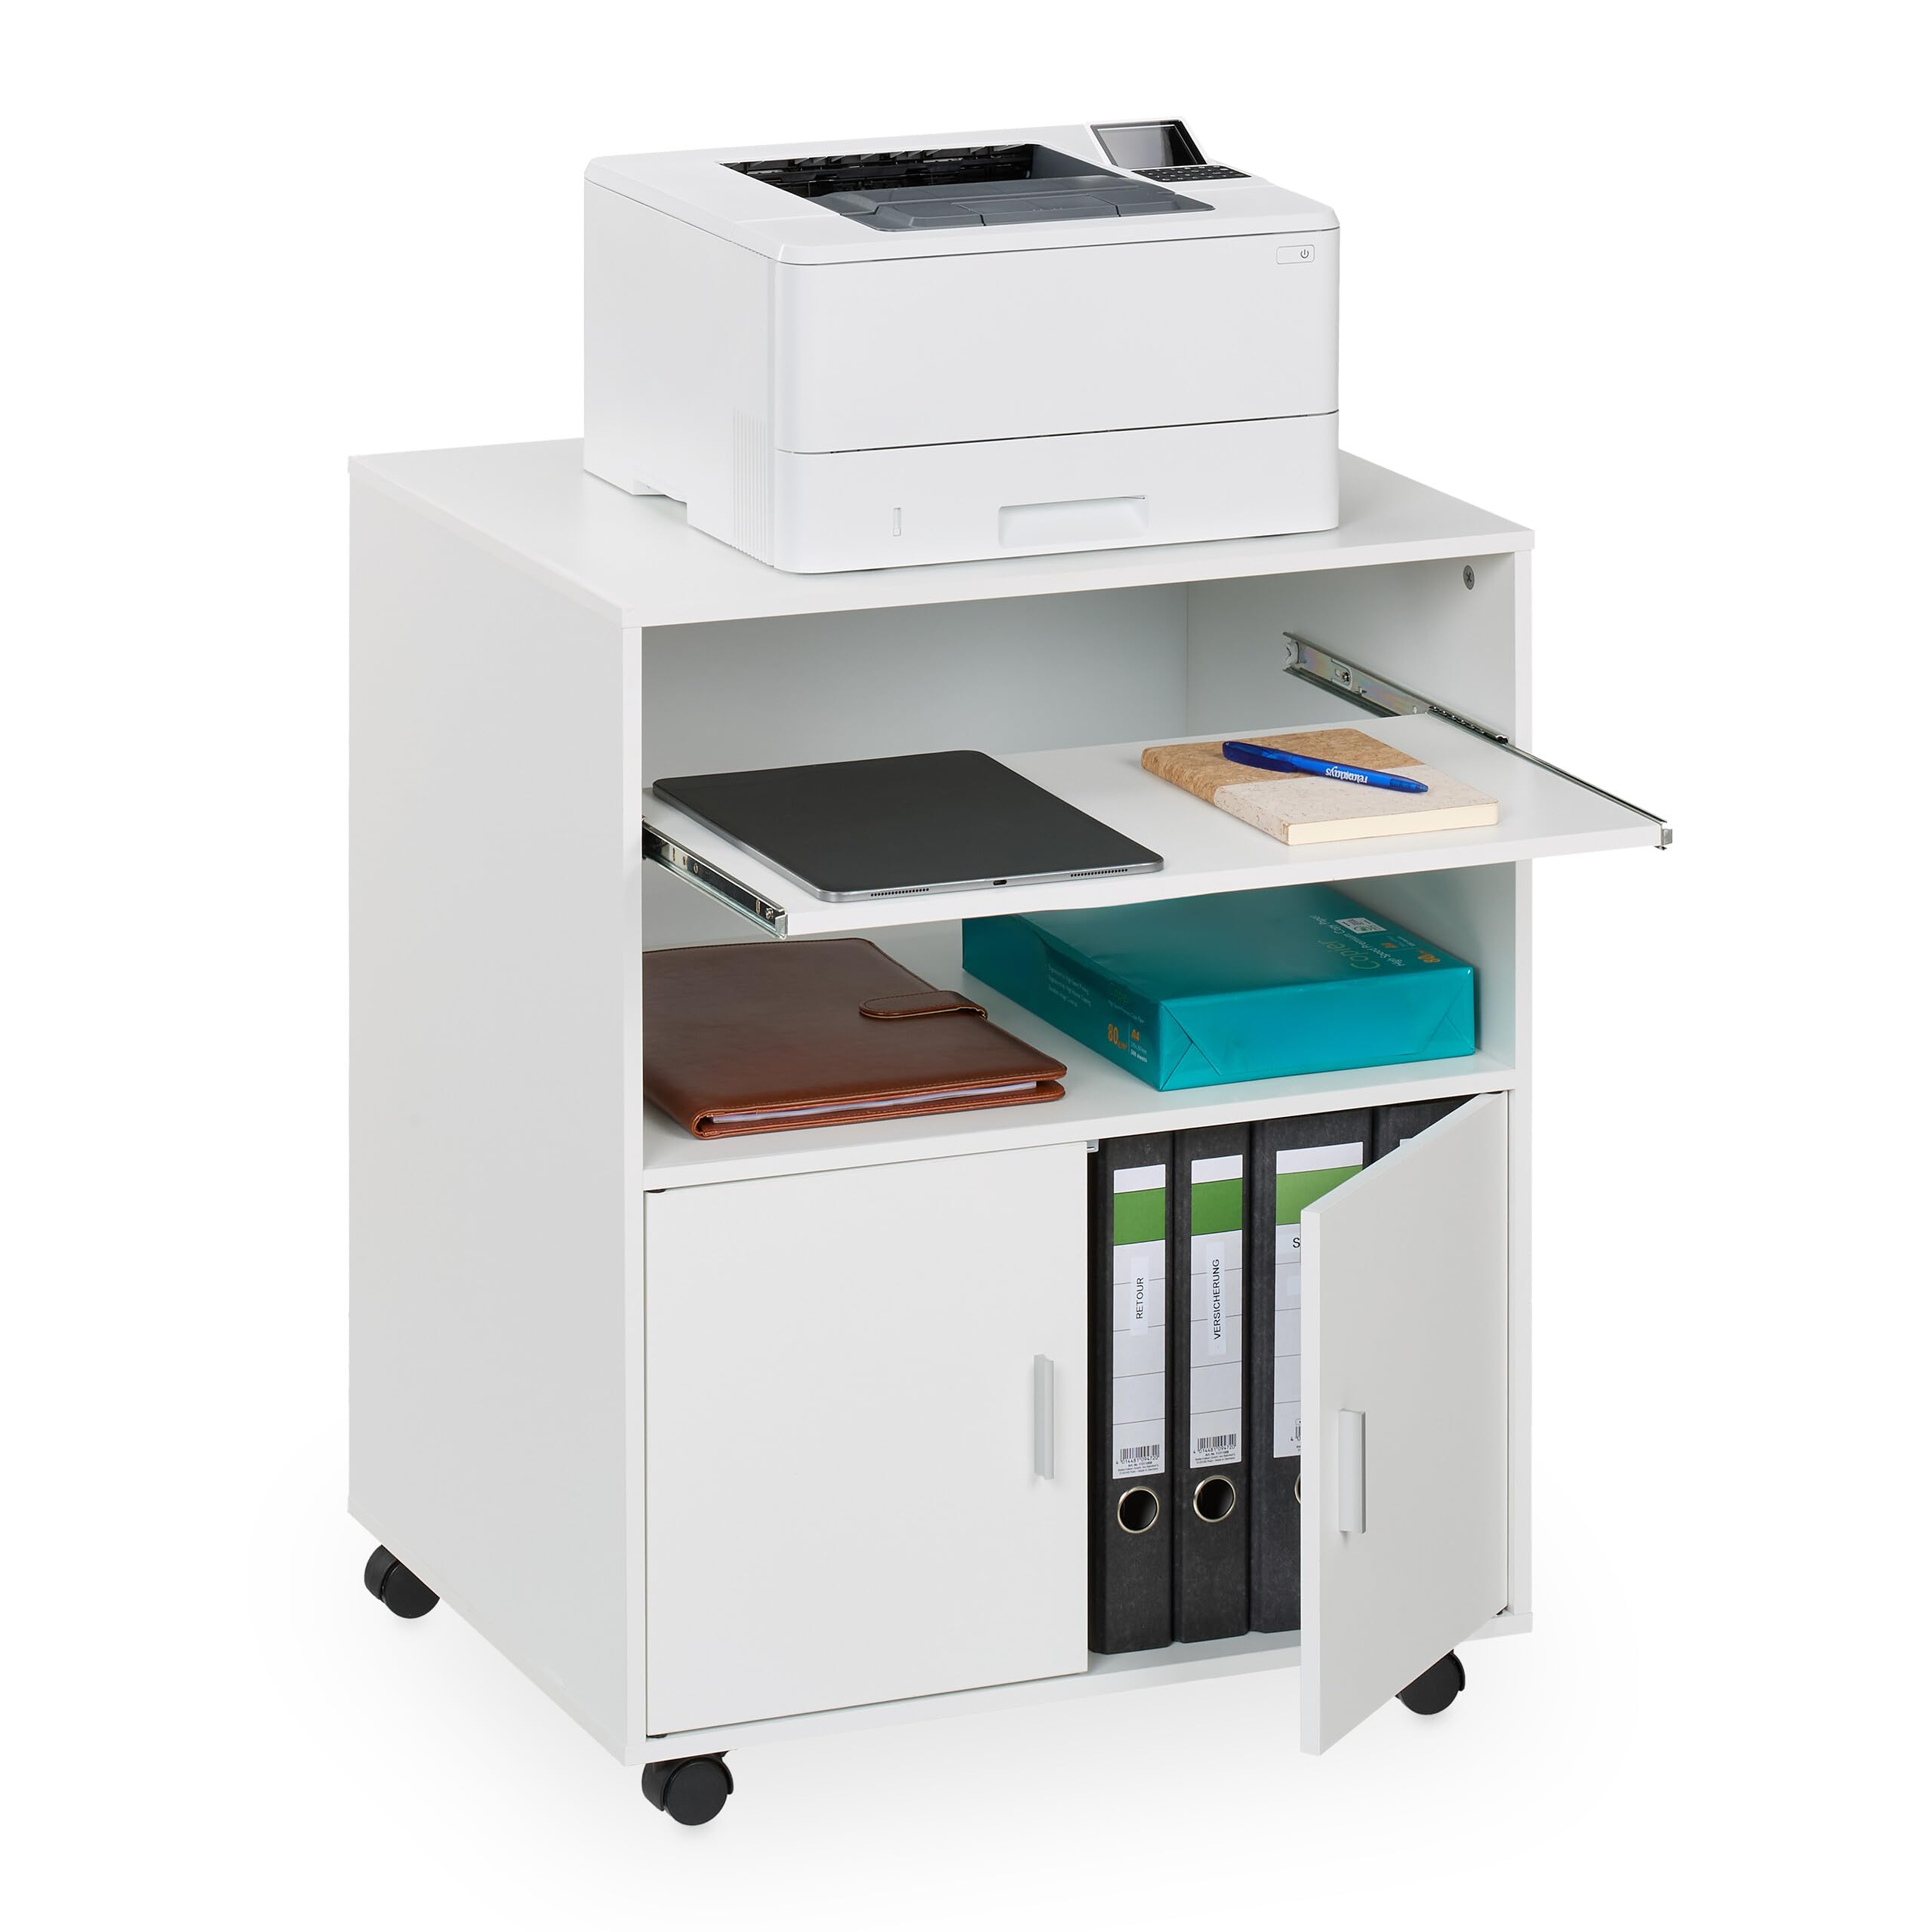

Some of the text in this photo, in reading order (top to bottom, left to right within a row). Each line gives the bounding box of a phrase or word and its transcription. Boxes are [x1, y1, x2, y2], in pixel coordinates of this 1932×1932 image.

[1317, 940, 1380, 970] Copier
[1108, 1023, 1118, 1045] 80
[1136, 1277, 1144, 1319] RETOUR
[1212, 1259, 1221, 1340] VERSICHERUNG
